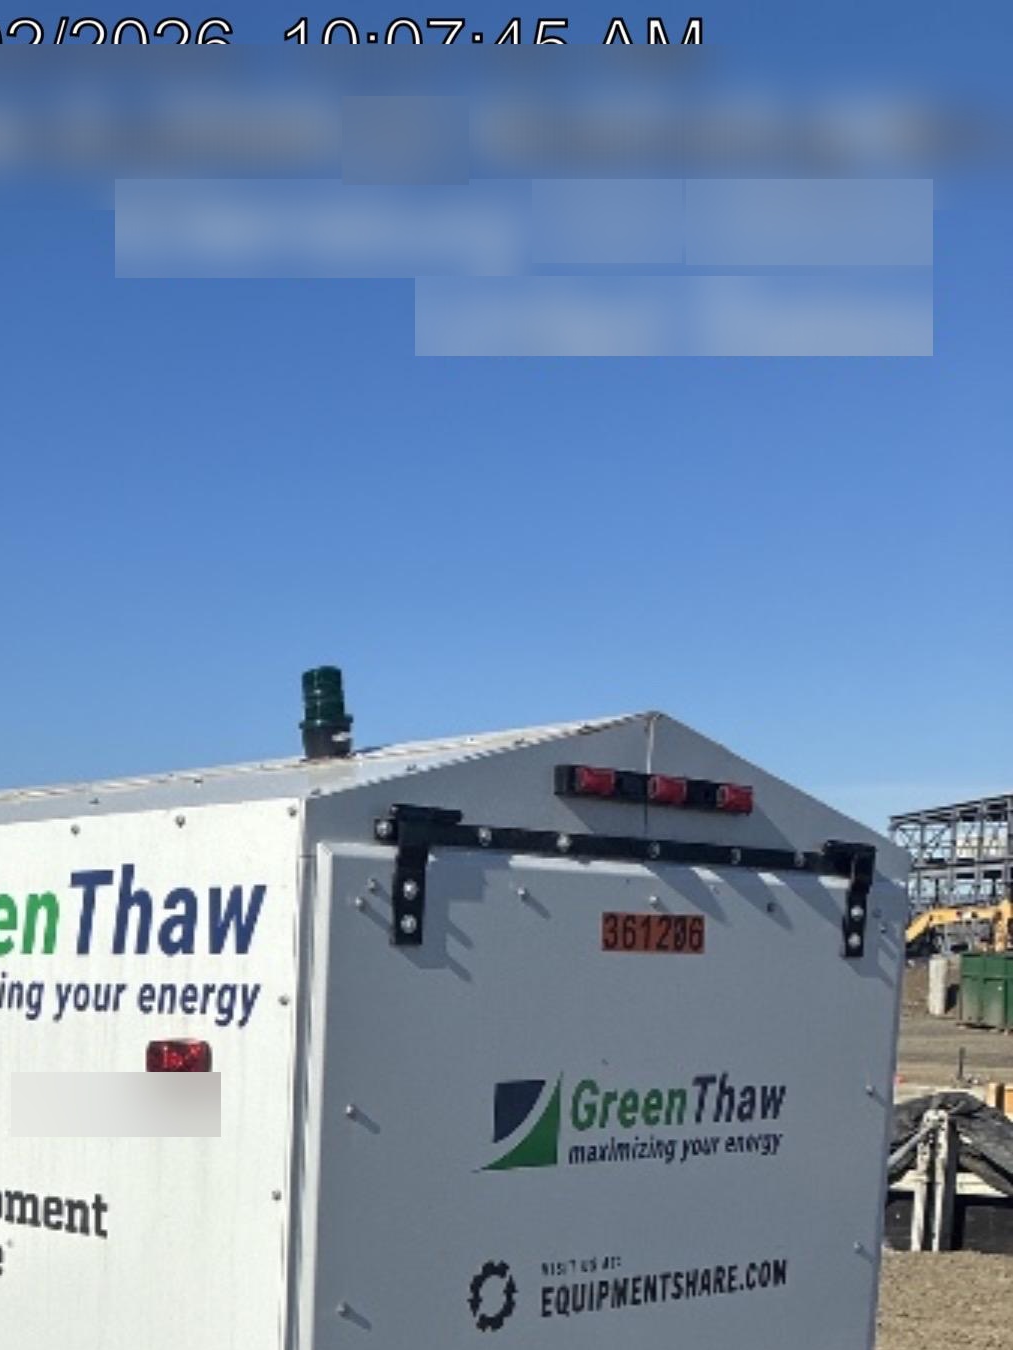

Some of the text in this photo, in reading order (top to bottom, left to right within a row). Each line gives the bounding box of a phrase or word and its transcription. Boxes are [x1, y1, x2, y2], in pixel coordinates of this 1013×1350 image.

[53, 983, 127, 1022] your
[137, 983, 261, 1027] energy
[568, 1133, 784, 1164] maximizing your energy
[541, 1259, 787, 1317] EQUIPMENTSHARE.COM
